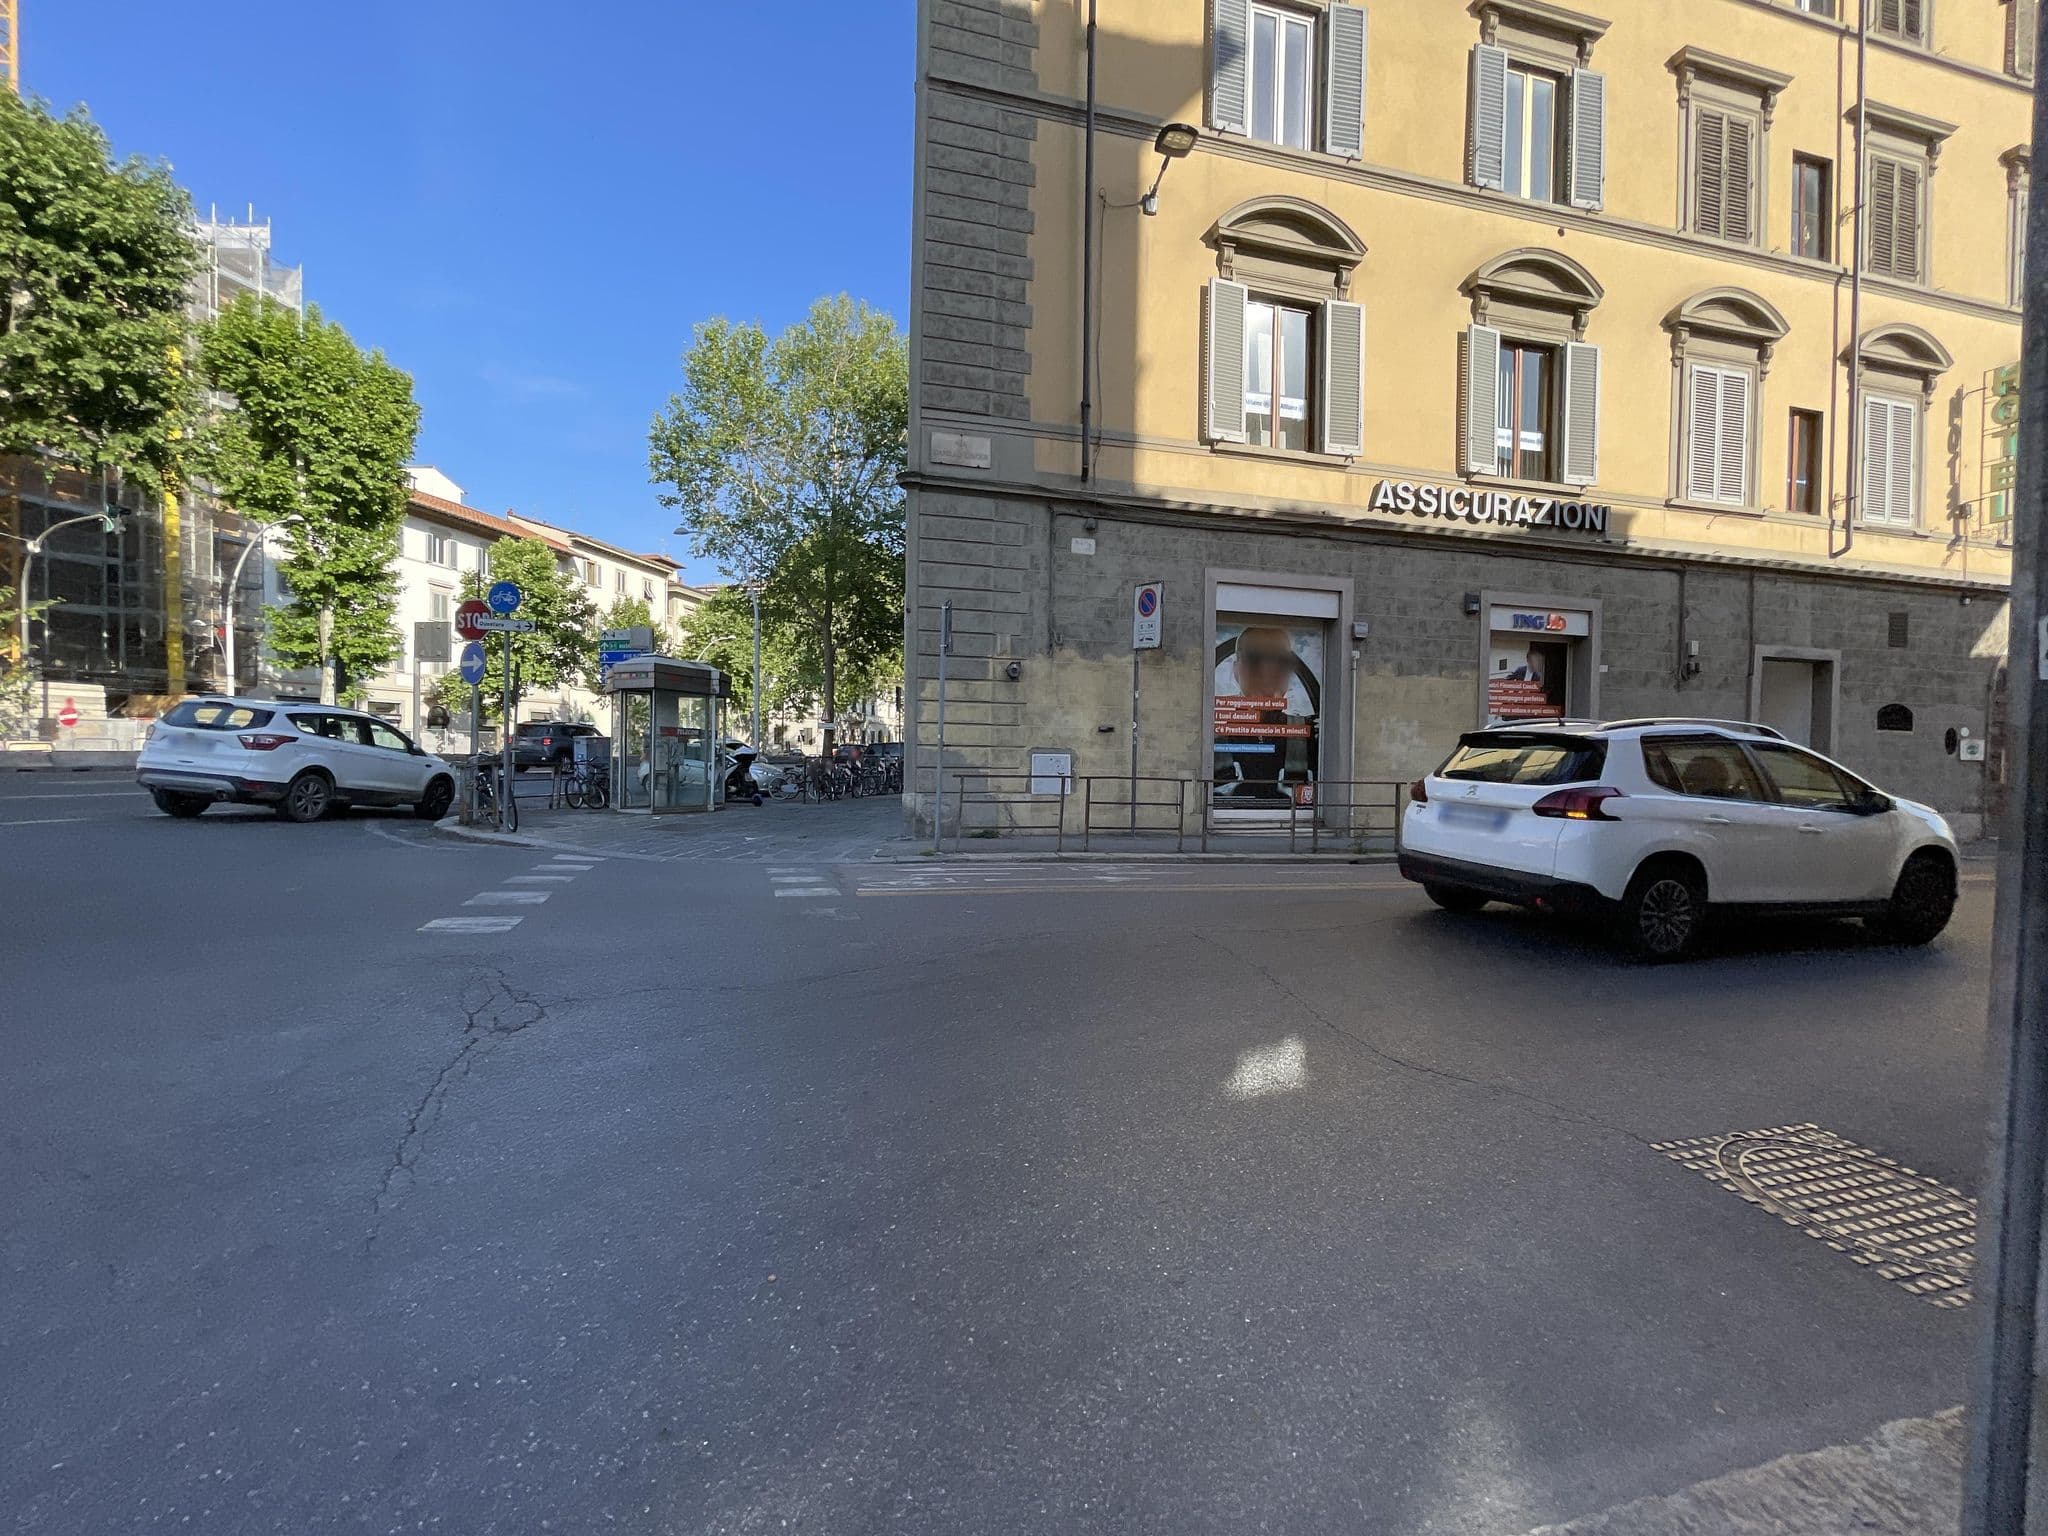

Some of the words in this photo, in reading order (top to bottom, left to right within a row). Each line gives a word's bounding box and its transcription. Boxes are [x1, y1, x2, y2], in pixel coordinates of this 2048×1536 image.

[1374, 480, 1611, 531] ASSICURAZIONI
[1513, 613, 1545, 629] ING
[1226, 699, 1264, 708] raggiungere
[1286, 727, 1308, 735] minuti.
